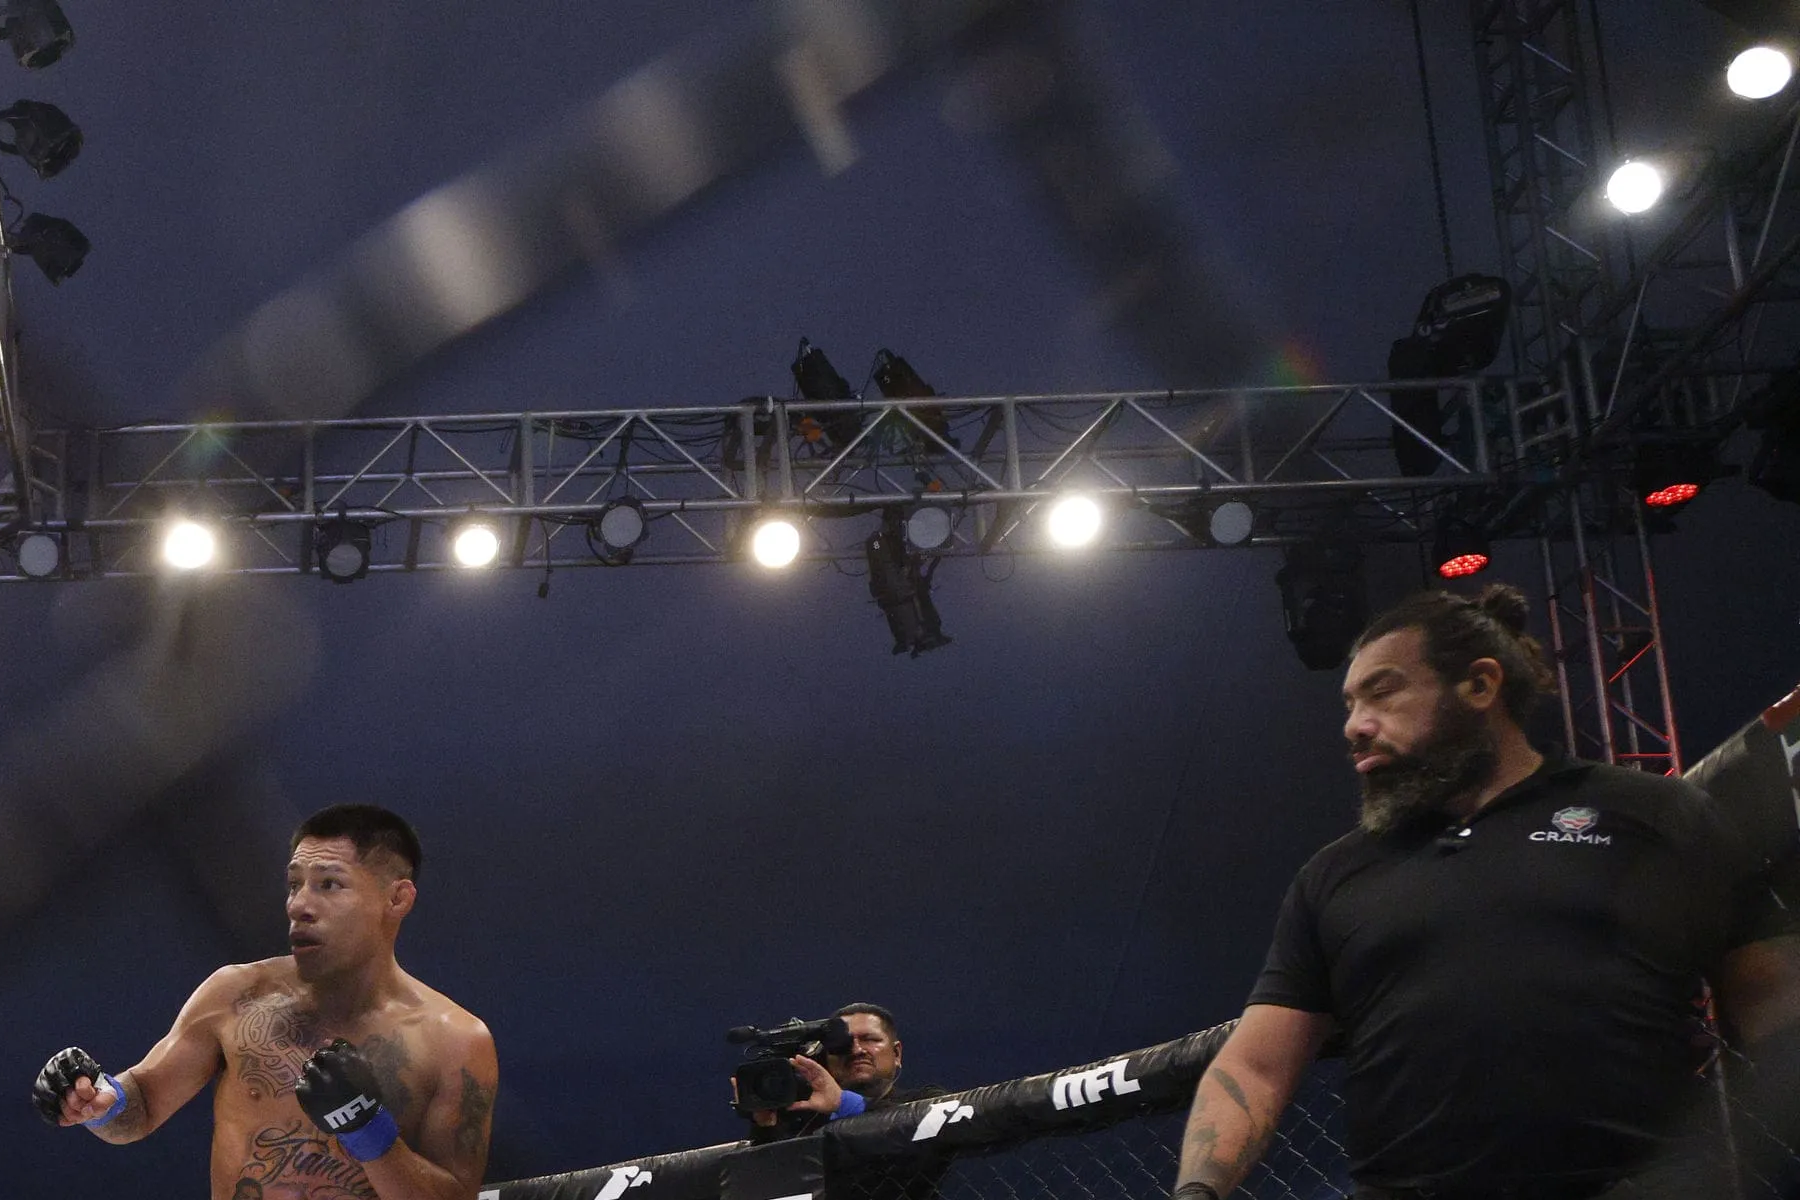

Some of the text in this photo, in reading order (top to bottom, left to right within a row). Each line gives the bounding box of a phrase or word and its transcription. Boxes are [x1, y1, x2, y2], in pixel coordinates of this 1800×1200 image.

[1528, 831, 1611, 846] CRAMM
[1052, 1059, 1141, 1111] MFL
[323, 1094, 377, 1129] MFL
